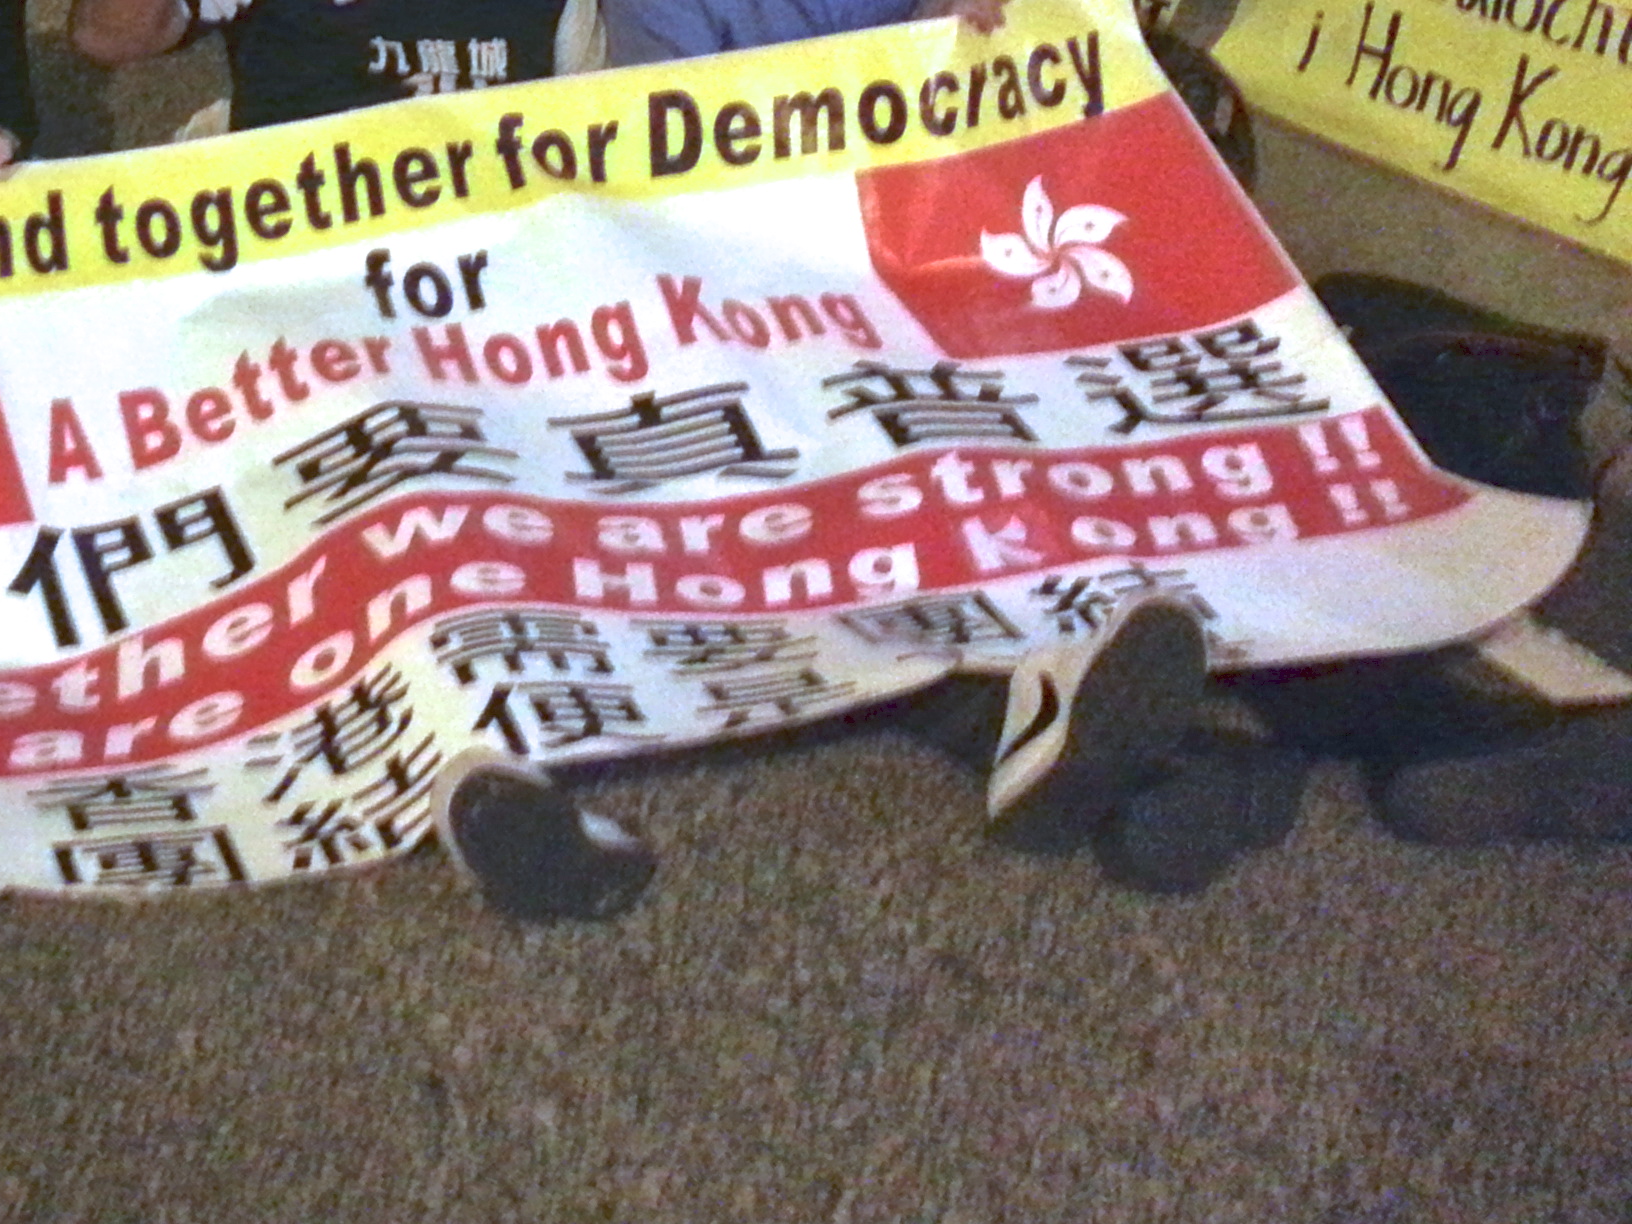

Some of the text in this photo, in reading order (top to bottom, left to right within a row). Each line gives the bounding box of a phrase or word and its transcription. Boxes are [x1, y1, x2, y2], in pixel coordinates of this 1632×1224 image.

[94, 140, 480, 273] together
[494, 110, 618, 192] for
[646, 28, 1108, 176] Democracy
[1297, 10, 1325, 74] i
[1491, 52, 1632, 226] Kong
[45, 273, 884, 486] A Better Hong Kong
[364, 247, 489, 319] for
[360, 500, 555, 561] we
[597, 501, 816, 559] are
[856, 441, 1274, 518] strong
[6, 689, 246, 769] are
[288, 558, 528, 691] one
[571, 540, 920, 611] Hong
